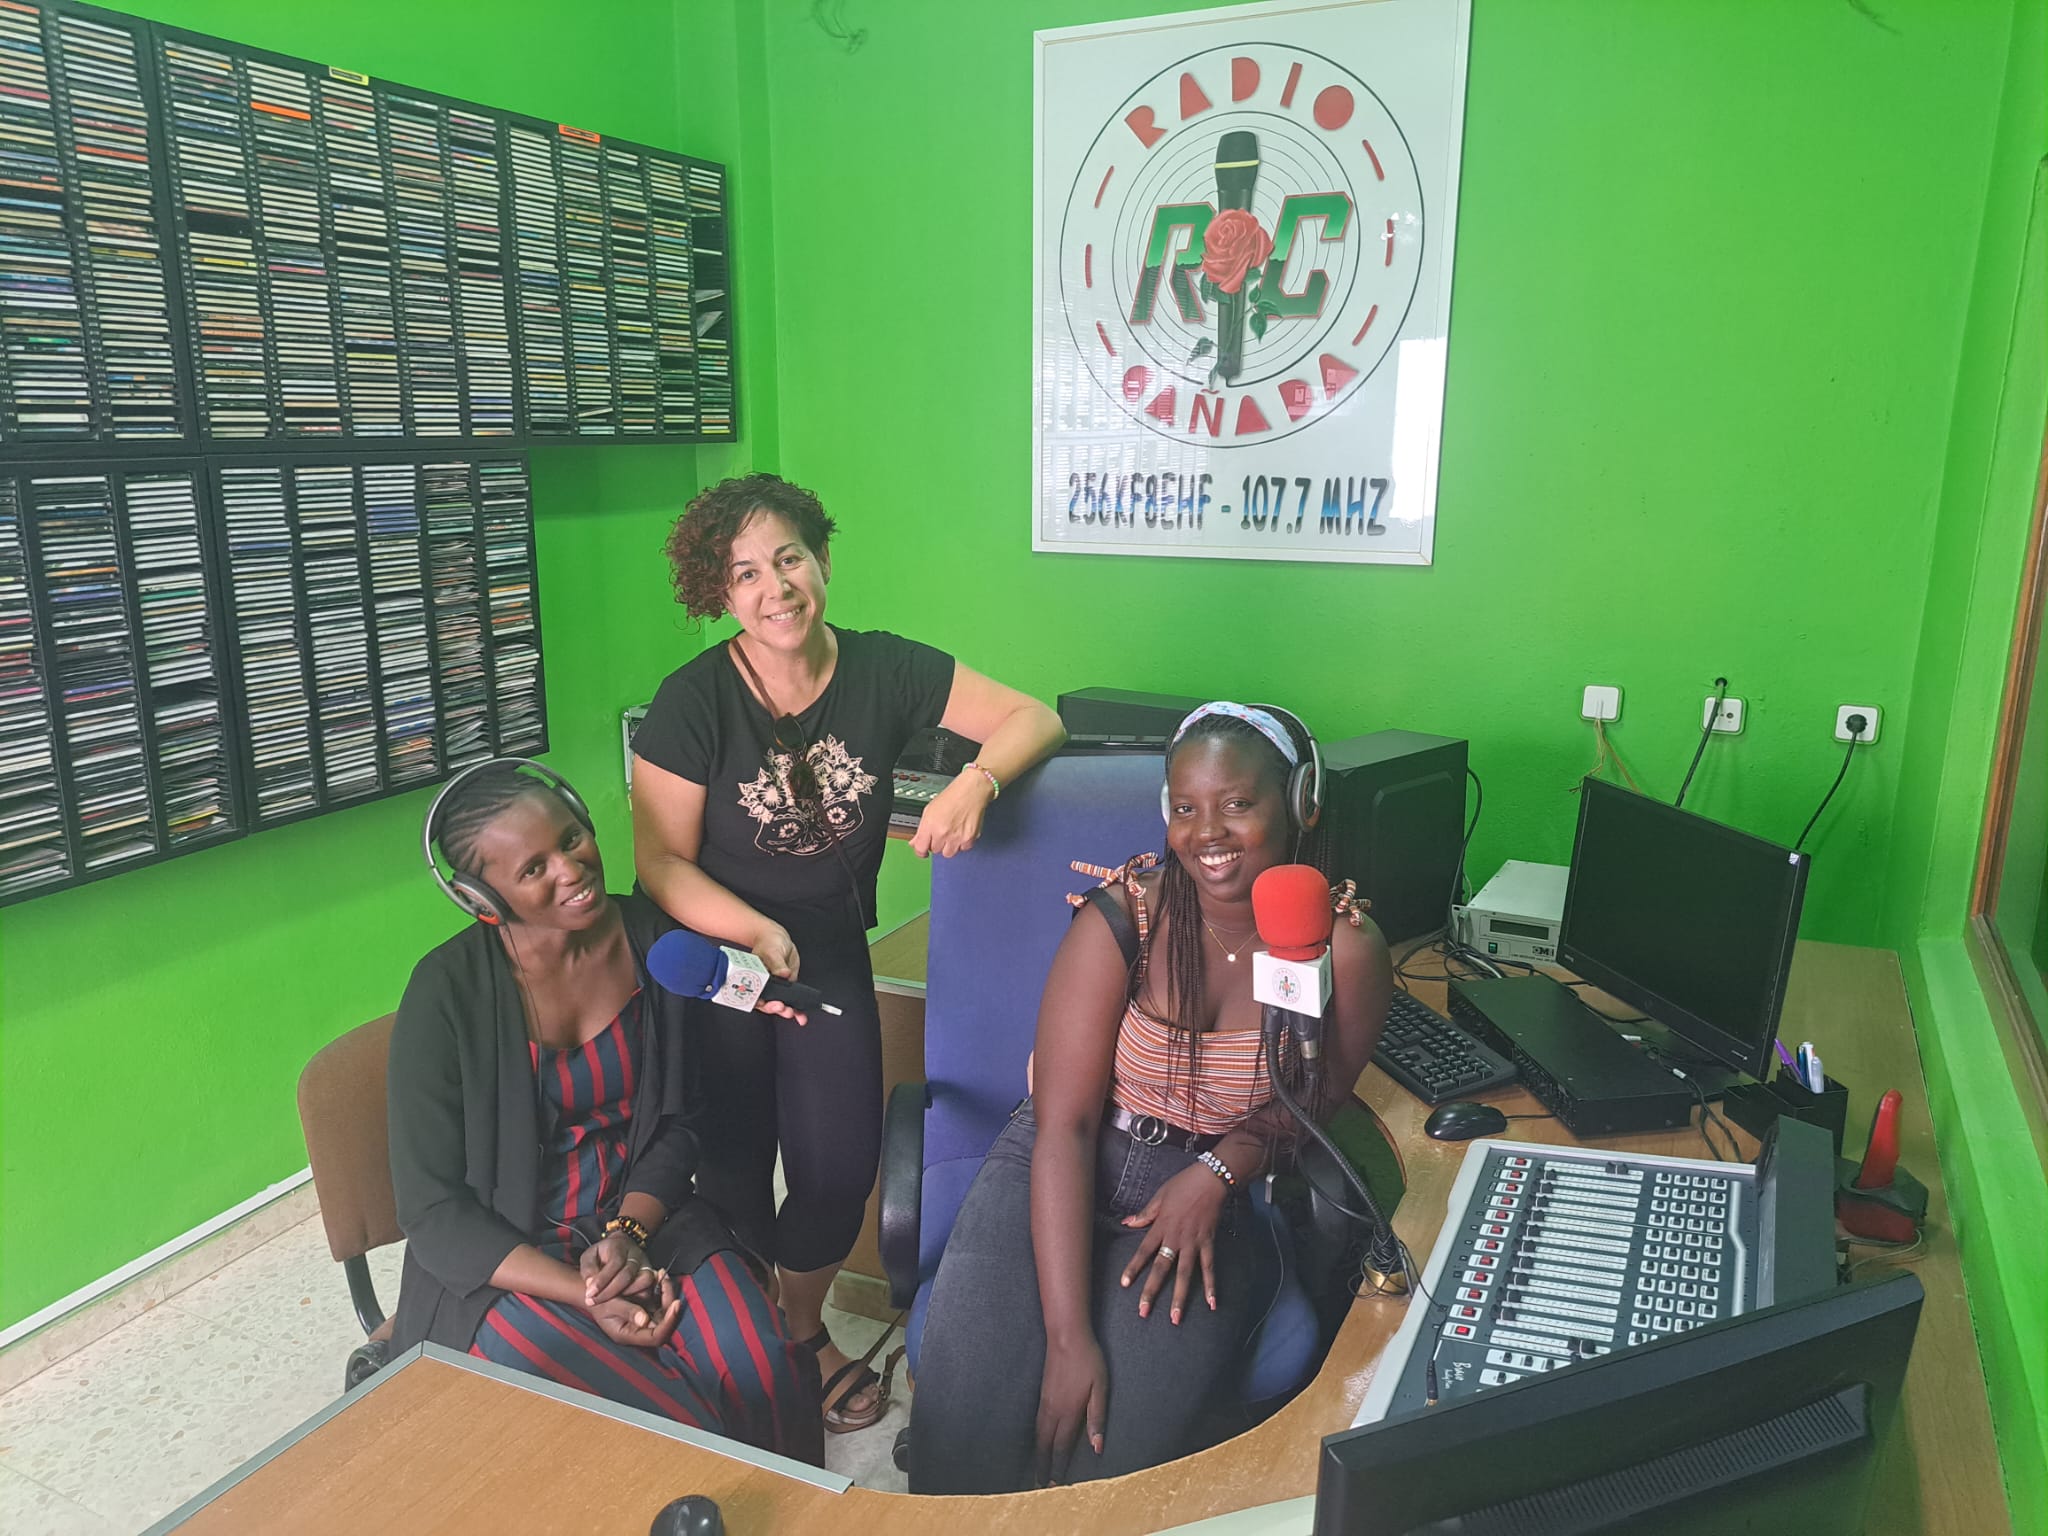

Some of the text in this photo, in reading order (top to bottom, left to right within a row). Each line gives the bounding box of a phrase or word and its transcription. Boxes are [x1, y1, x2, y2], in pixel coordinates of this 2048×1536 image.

[1124, 57, 1355, 149] RADIO
[1122, 353, 1359, 437] CAÑADA
[1241, 475, 1311, 534] 107.7
[1319, 477, 1388, 536] MHZ
